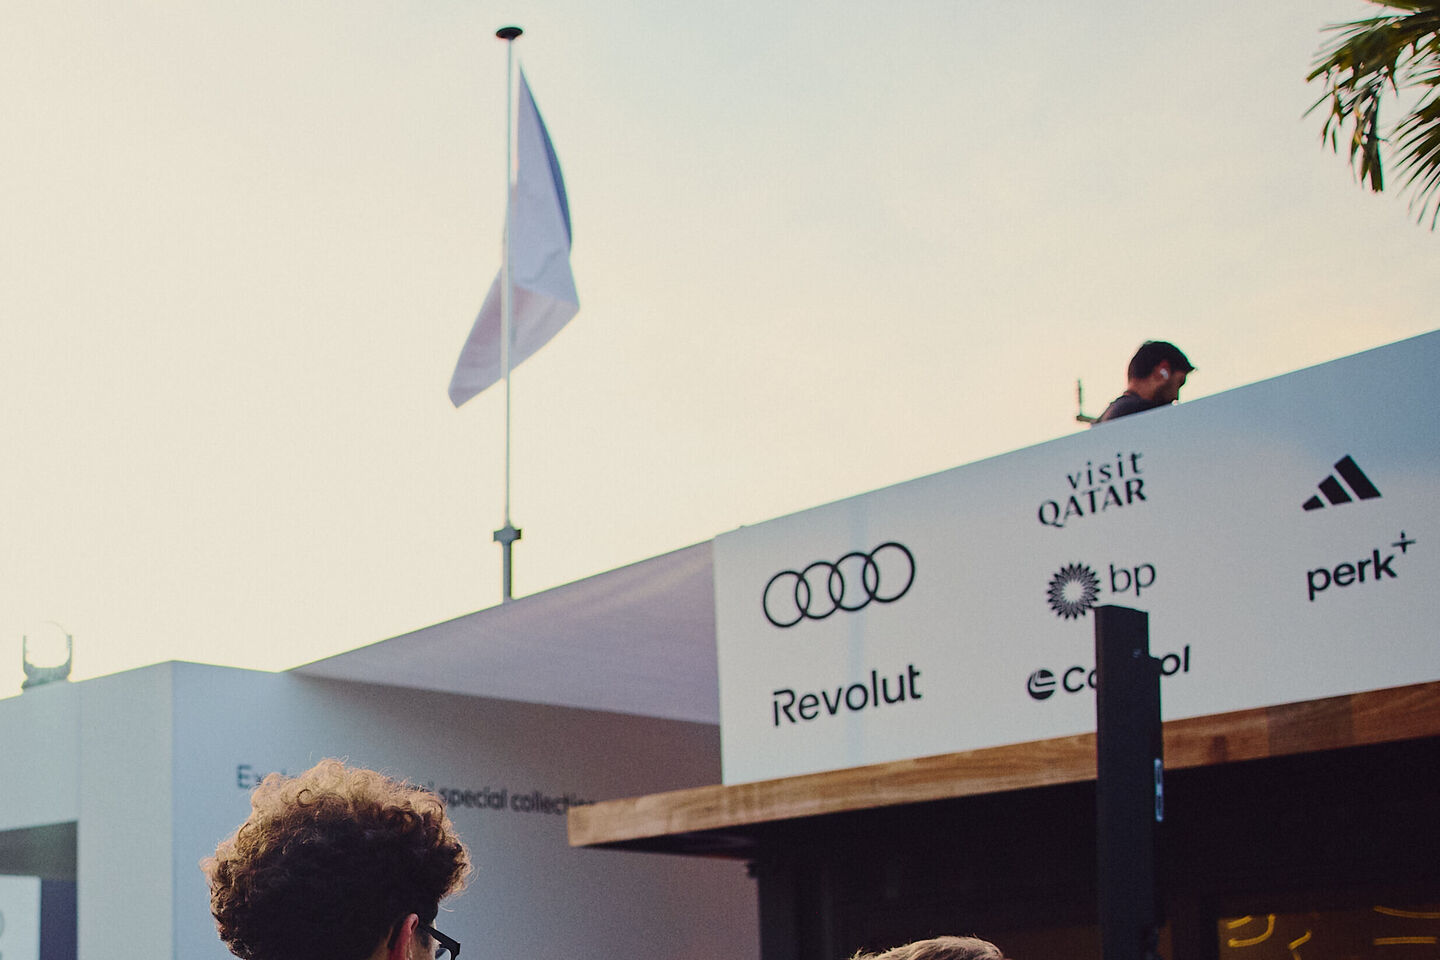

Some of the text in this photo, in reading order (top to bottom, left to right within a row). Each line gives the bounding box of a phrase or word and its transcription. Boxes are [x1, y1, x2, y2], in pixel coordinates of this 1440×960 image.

[1067, 453, 1143, 489] visit
[1038, 478, 1146, 528] QATAR
[1109, 563, 1156, 597] bp
[773, 664, 922, 727] Revolut
